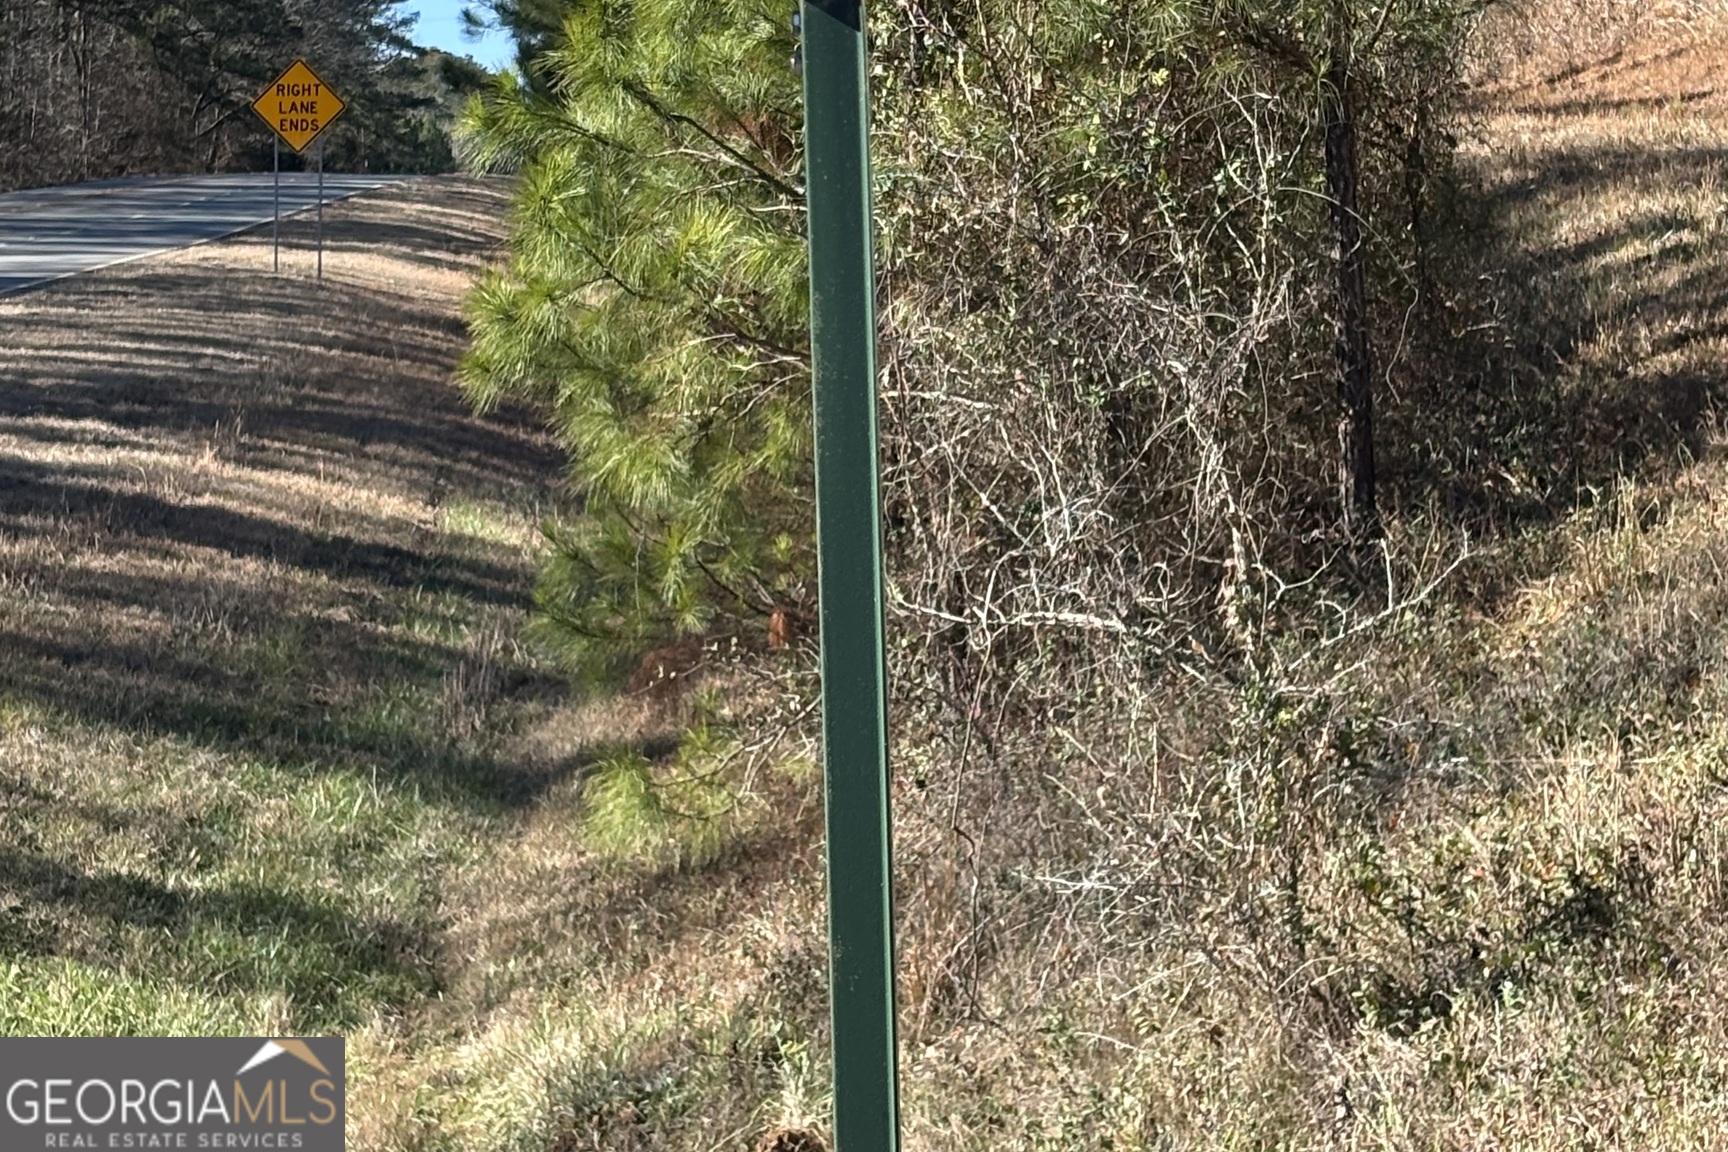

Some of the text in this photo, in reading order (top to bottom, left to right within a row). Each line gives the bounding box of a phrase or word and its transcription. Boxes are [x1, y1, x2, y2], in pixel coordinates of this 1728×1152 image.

[276, 83, 321, 97] RIGHT
[278, 101, 318, 115] LANE
[279, 119, 320, 132] ENDS
